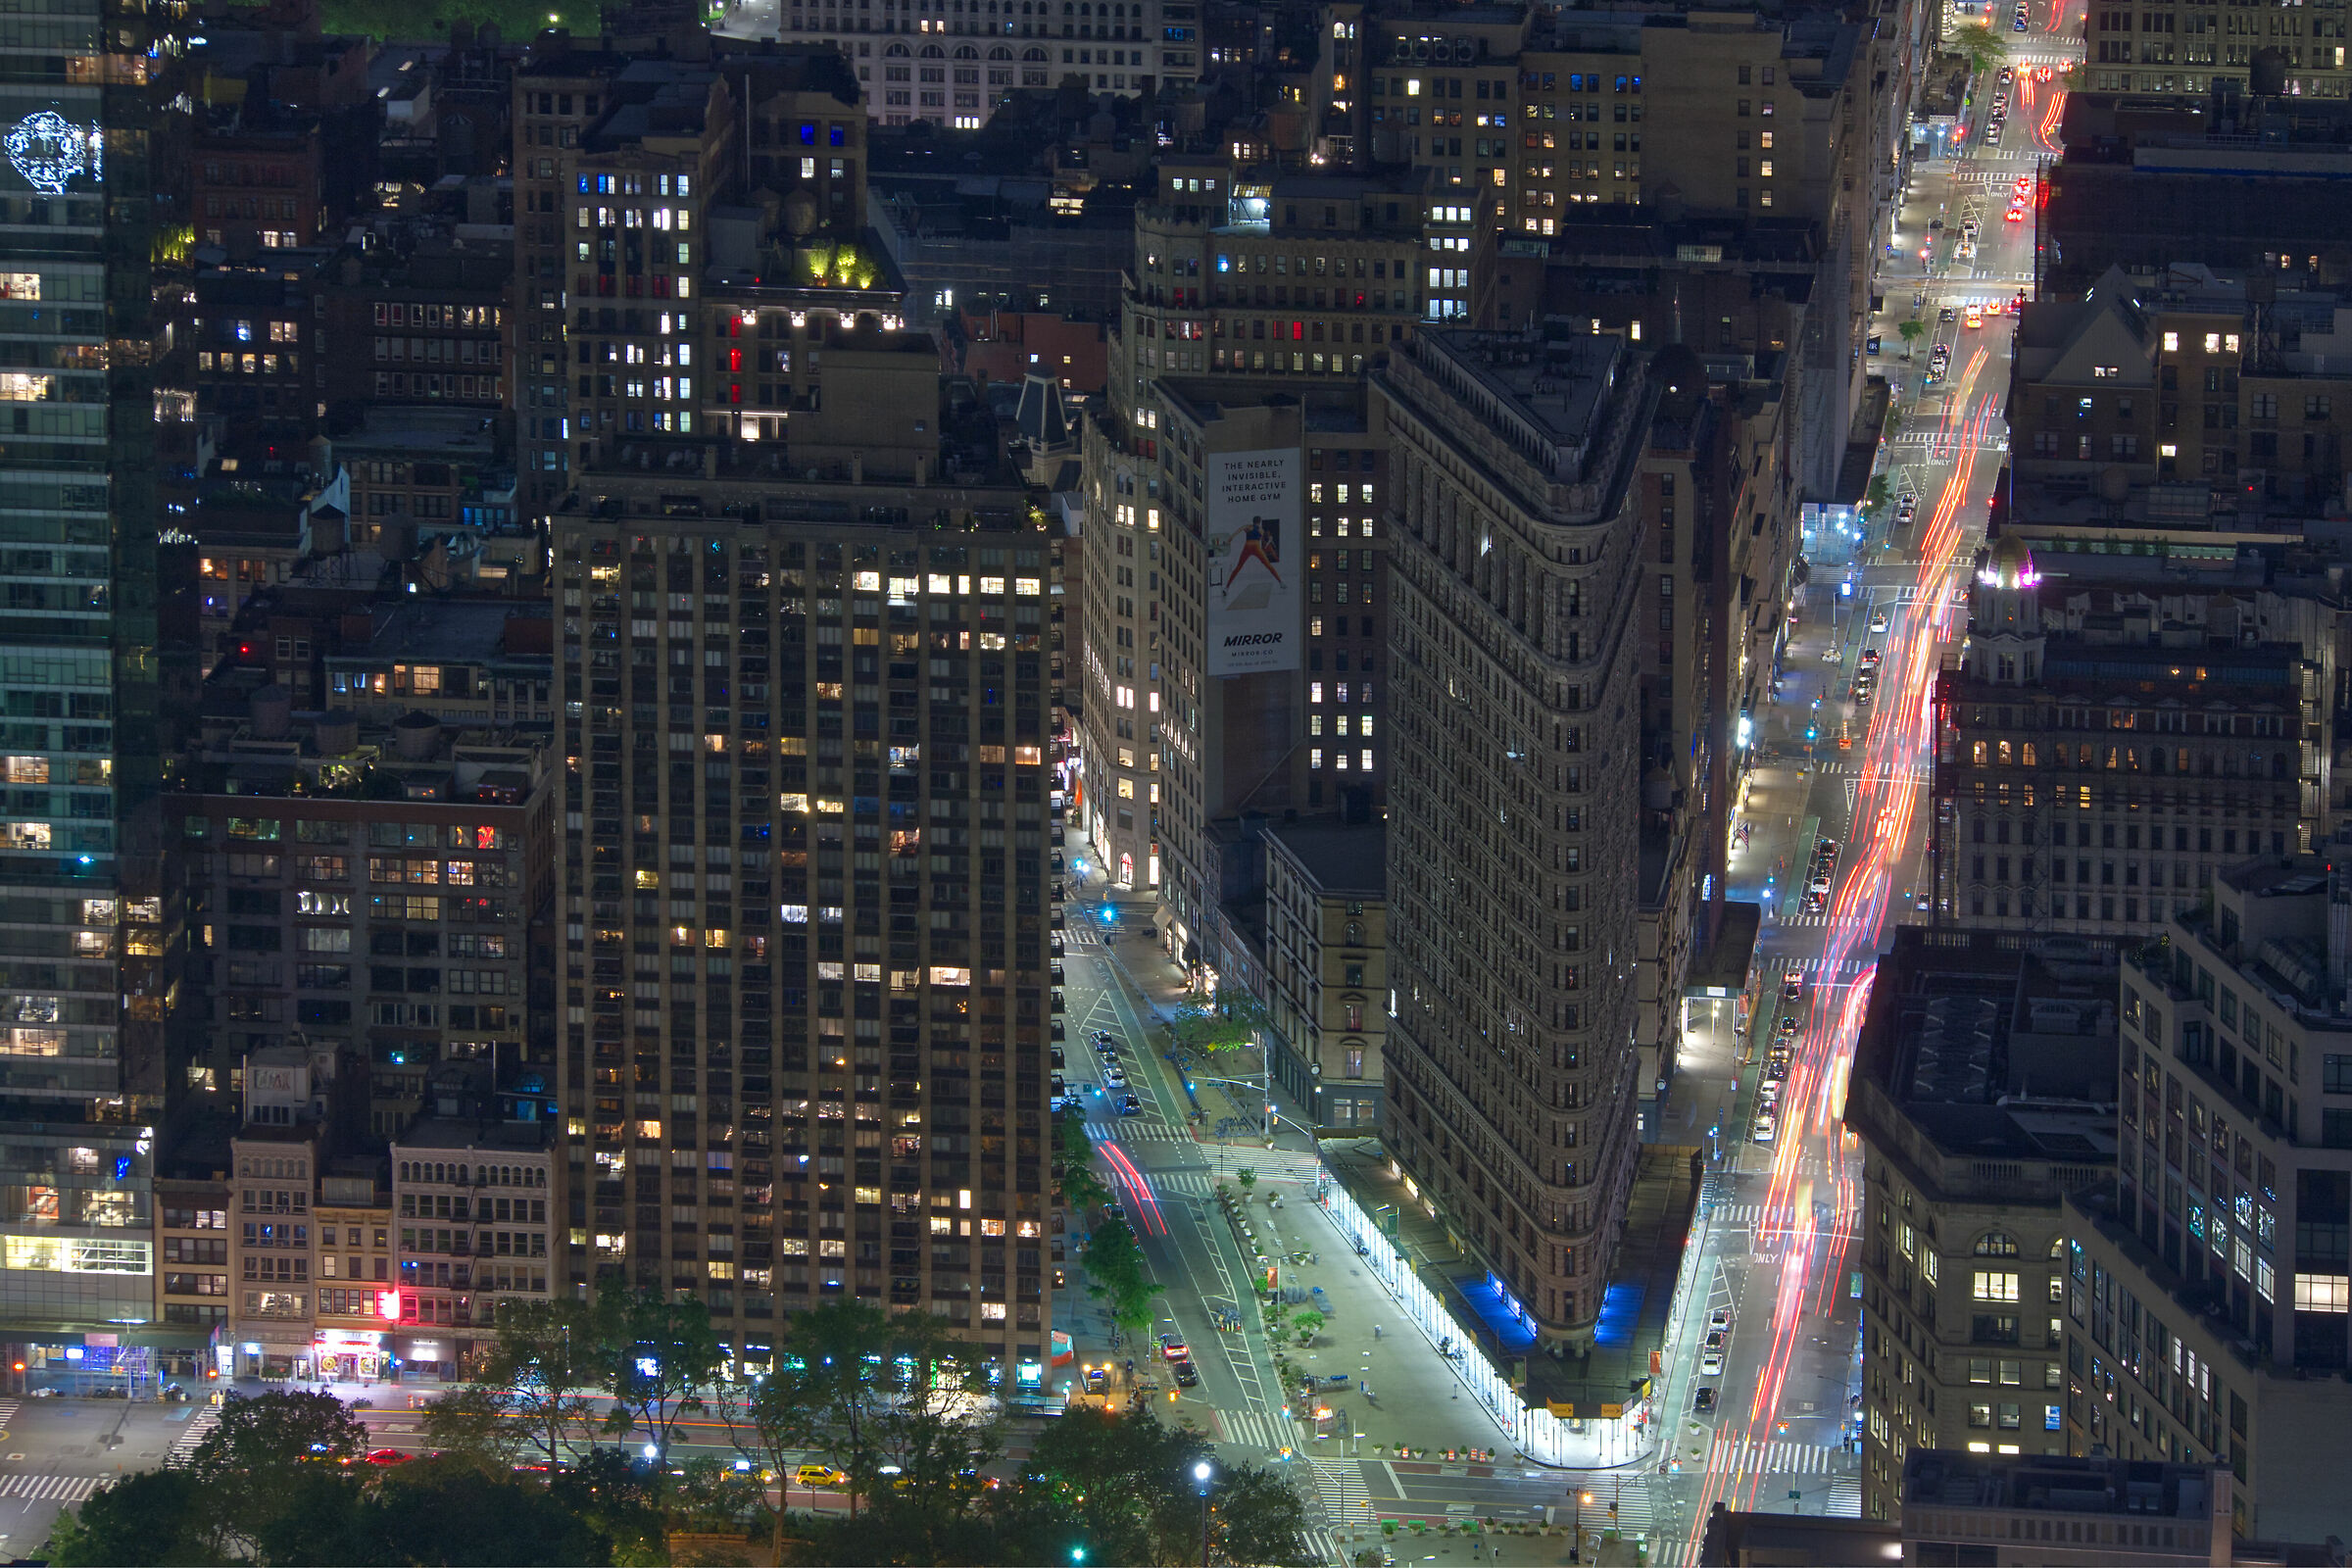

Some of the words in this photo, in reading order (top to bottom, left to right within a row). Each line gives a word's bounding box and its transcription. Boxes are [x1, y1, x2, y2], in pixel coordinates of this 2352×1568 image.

[1247, 459, 1284, 468] NEARLY
[1228, 470, 1281, 481] INVISIBLE,
[1222, 481, 1286, 492] INTERACTIVE
[1227, 494, 1256, 503] HOME
[1223, 632, 1283, 647] MIRROR
